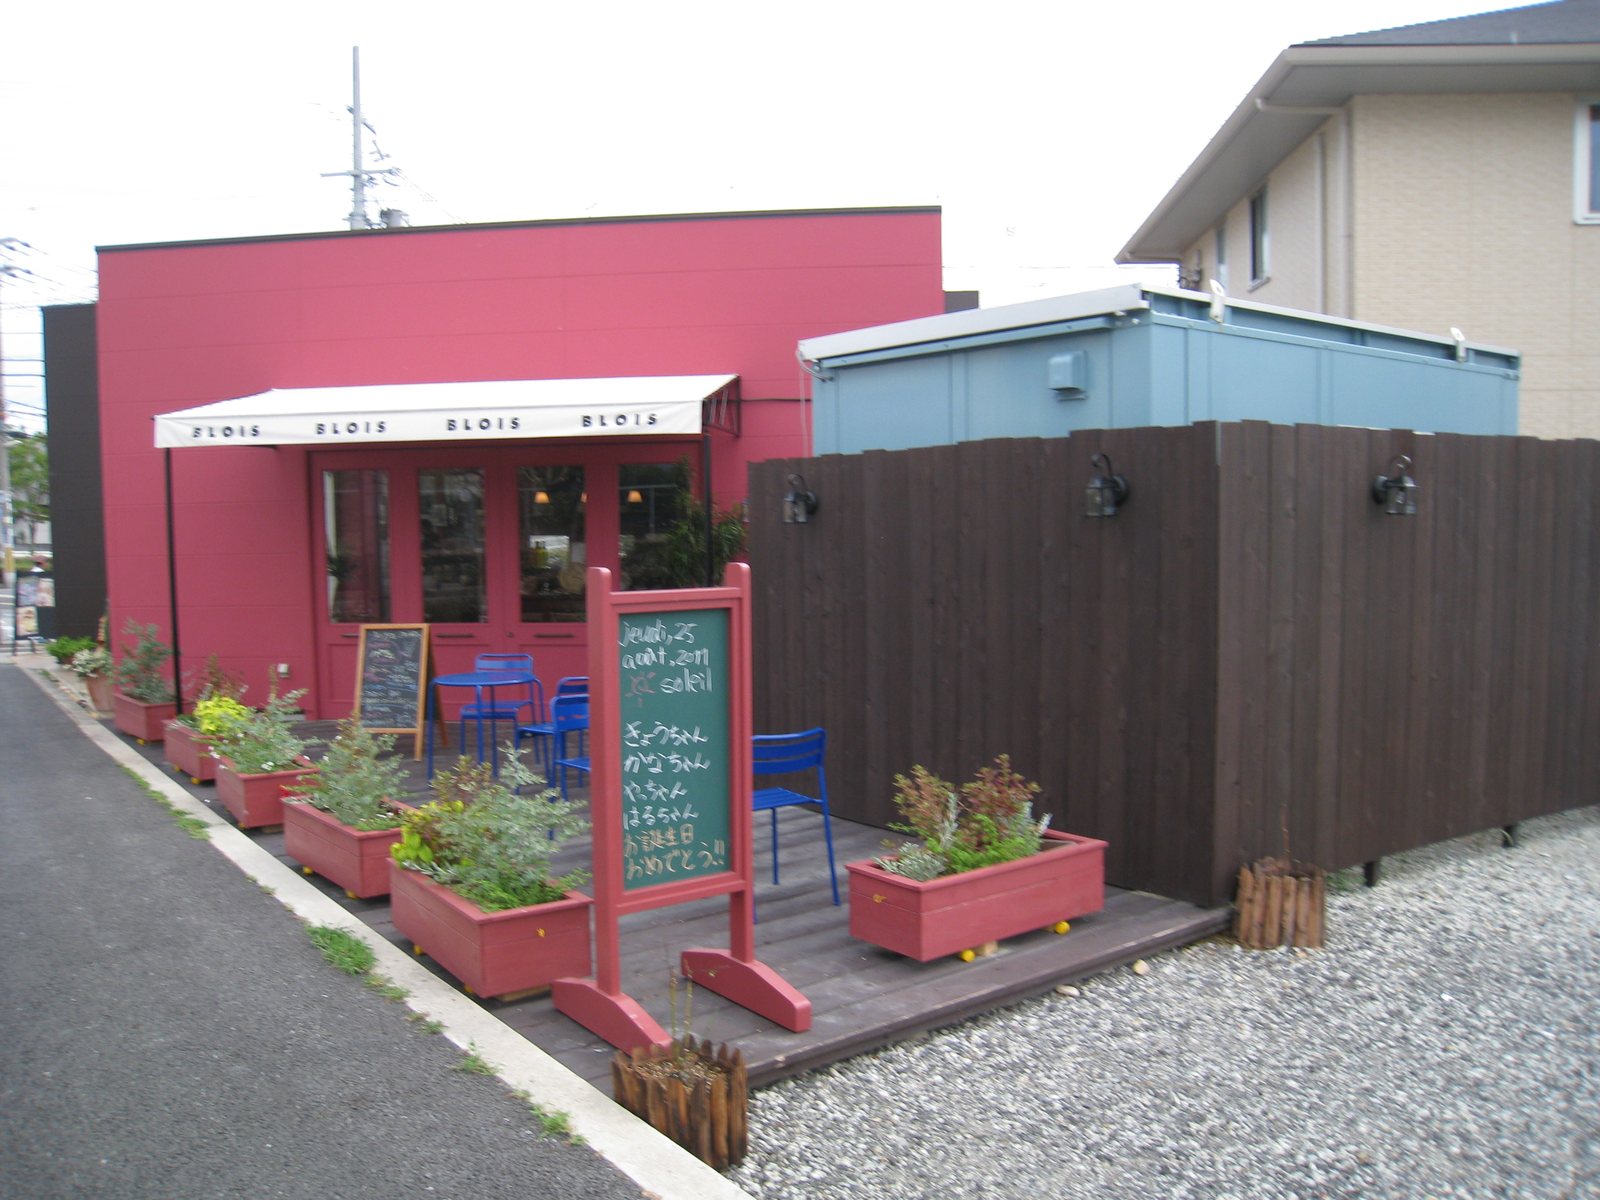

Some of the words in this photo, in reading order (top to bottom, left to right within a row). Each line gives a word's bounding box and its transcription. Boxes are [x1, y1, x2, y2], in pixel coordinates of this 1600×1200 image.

[447, 417, 520, 431] BLOIS
[582, 413, 658, 428] BLOIS
[193, 425, 260, 438] BLOIS
[315, 421, 387, 435] BLOIS
[660, 667, 712, 693] soleil
